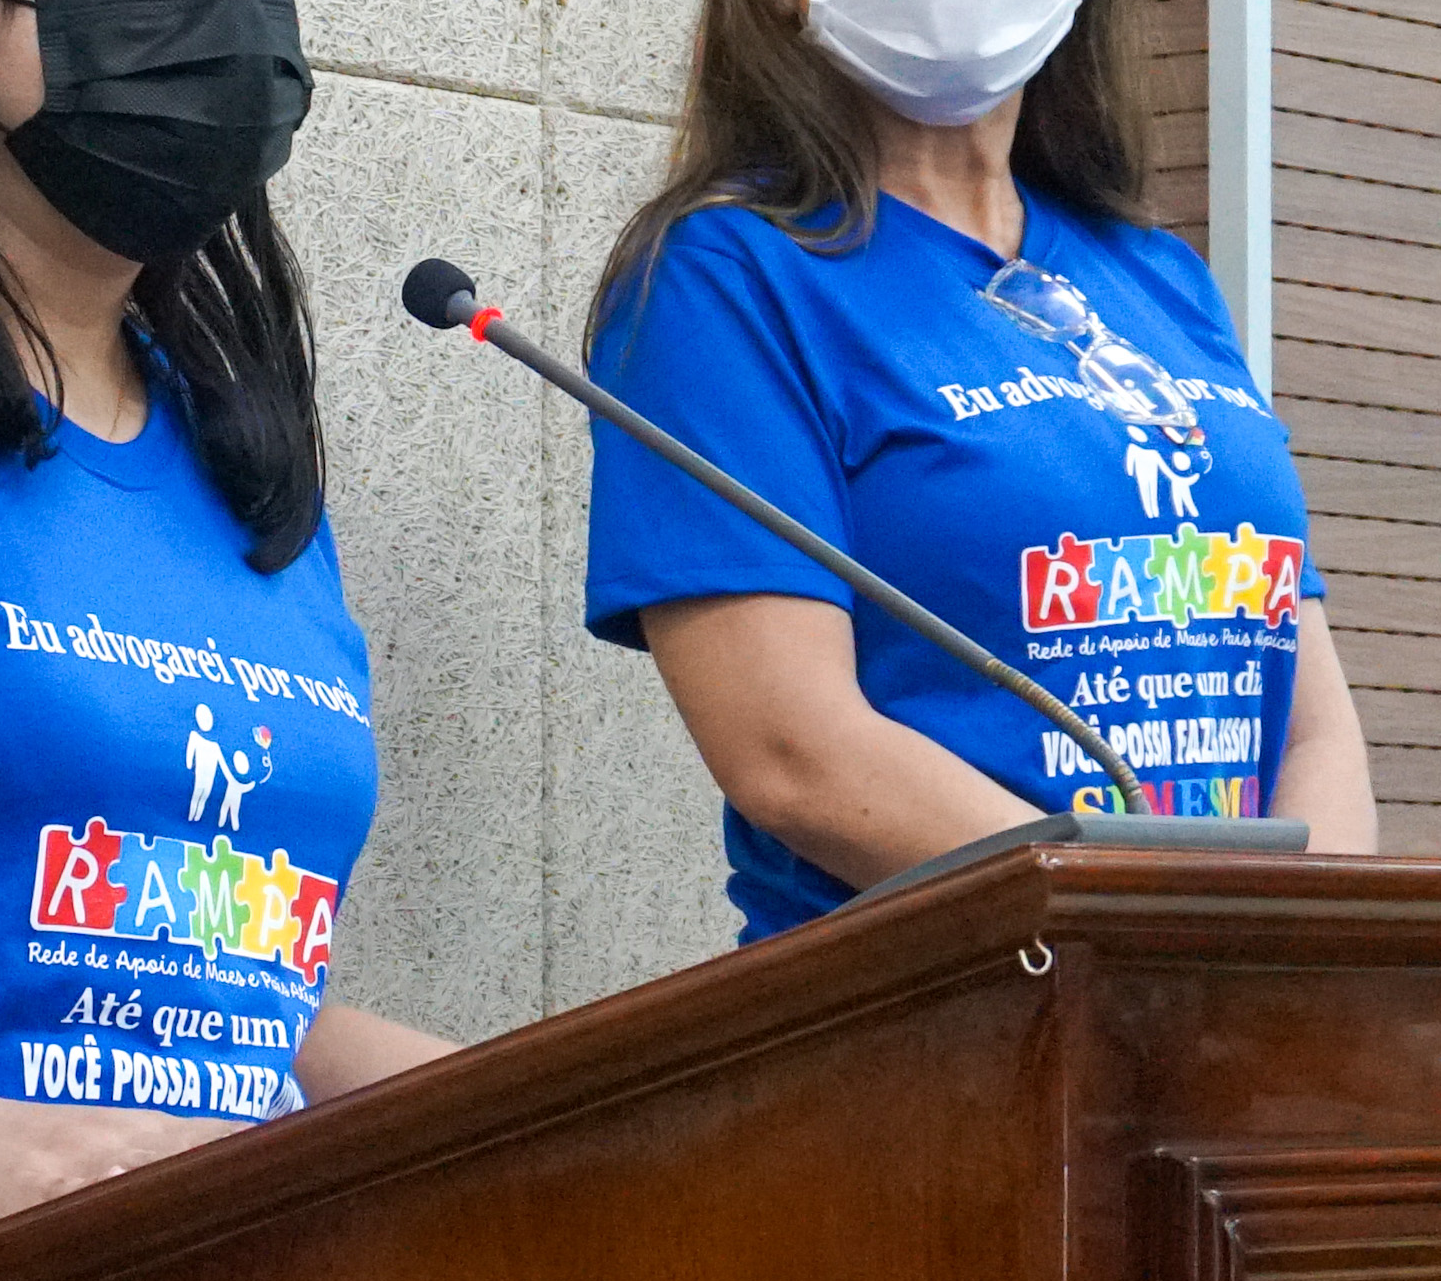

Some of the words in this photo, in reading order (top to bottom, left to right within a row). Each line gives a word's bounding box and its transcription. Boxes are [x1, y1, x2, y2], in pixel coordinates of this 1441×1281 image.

[936, 383, 1004, 422] Eu
[1038, 550, 1298, 622] RAMPA
[0, 601, 66, 654] Eu
[66, 613, 235, 684] advogarei
[231, 656, 295, 702] por
[1027, 637, 1073, 660] Rede
[1099, 633, 1150, 658] Apoio
[1153, 628, 1171, 649] de
[1222, 628, 1251, 648] Pais
[1069, 665, 1131, 708] Até
[1138, 671, 1194, 709] que
[48, 846, 333, 963] RAMPA
[28, 941, 80, 968] Rede
[85, 944, 110, 970] de
[116, 950, 178, 980] Apoio
[183, 954, 202, 980] de
[60, 987, 142, 1030] Até
[153, 1005, 224, 1048] que
[231, 1014, 290, 1049] um
[20, 1034, 102, 1100] VOCÊ
[111, 1048, 201, 1108] POSSA
